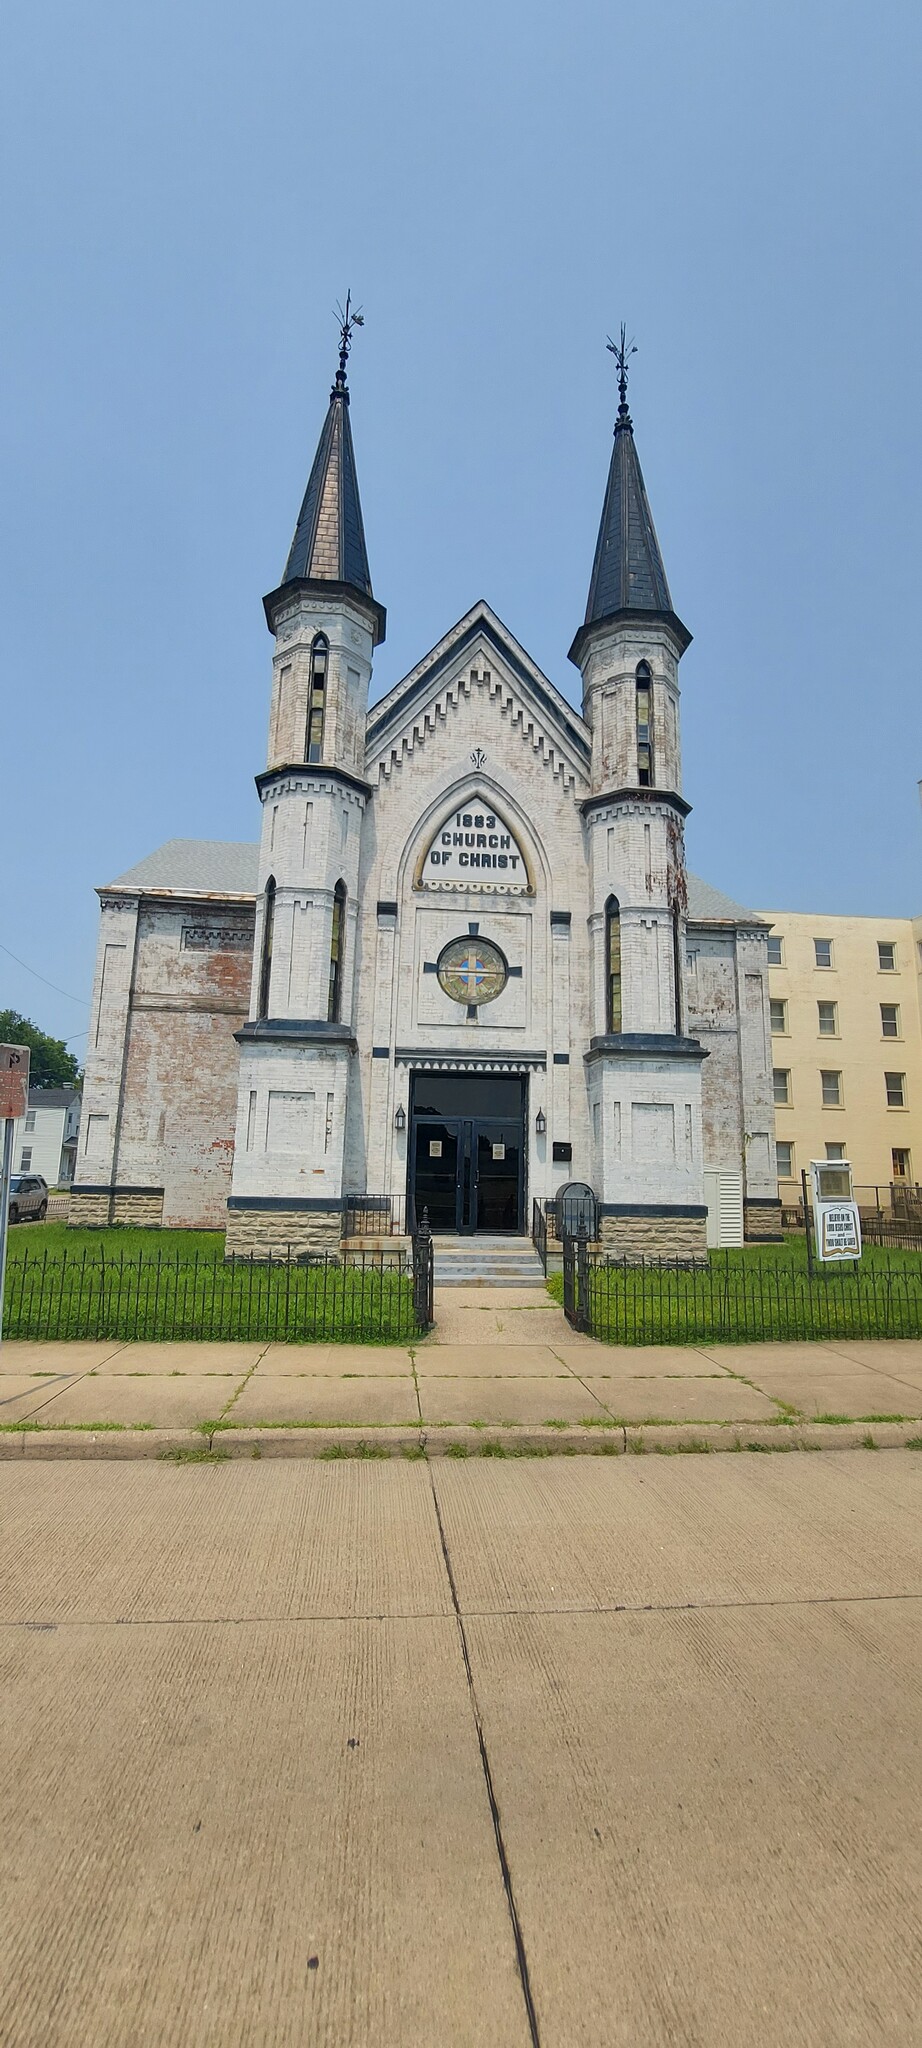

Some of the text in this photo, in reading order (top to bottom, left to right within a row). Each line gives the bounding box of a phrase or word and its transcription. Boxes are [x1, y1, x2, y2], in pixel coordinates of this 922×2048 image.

[456, 813, 496, 829] 1883
[441, 832, 511, 849] CHURCH
[430, 851, 520, 869] OF CHRIST
[835, 1223, 843, 1231] JESUS
[844, 1223, 853, 1231] CHRIST
